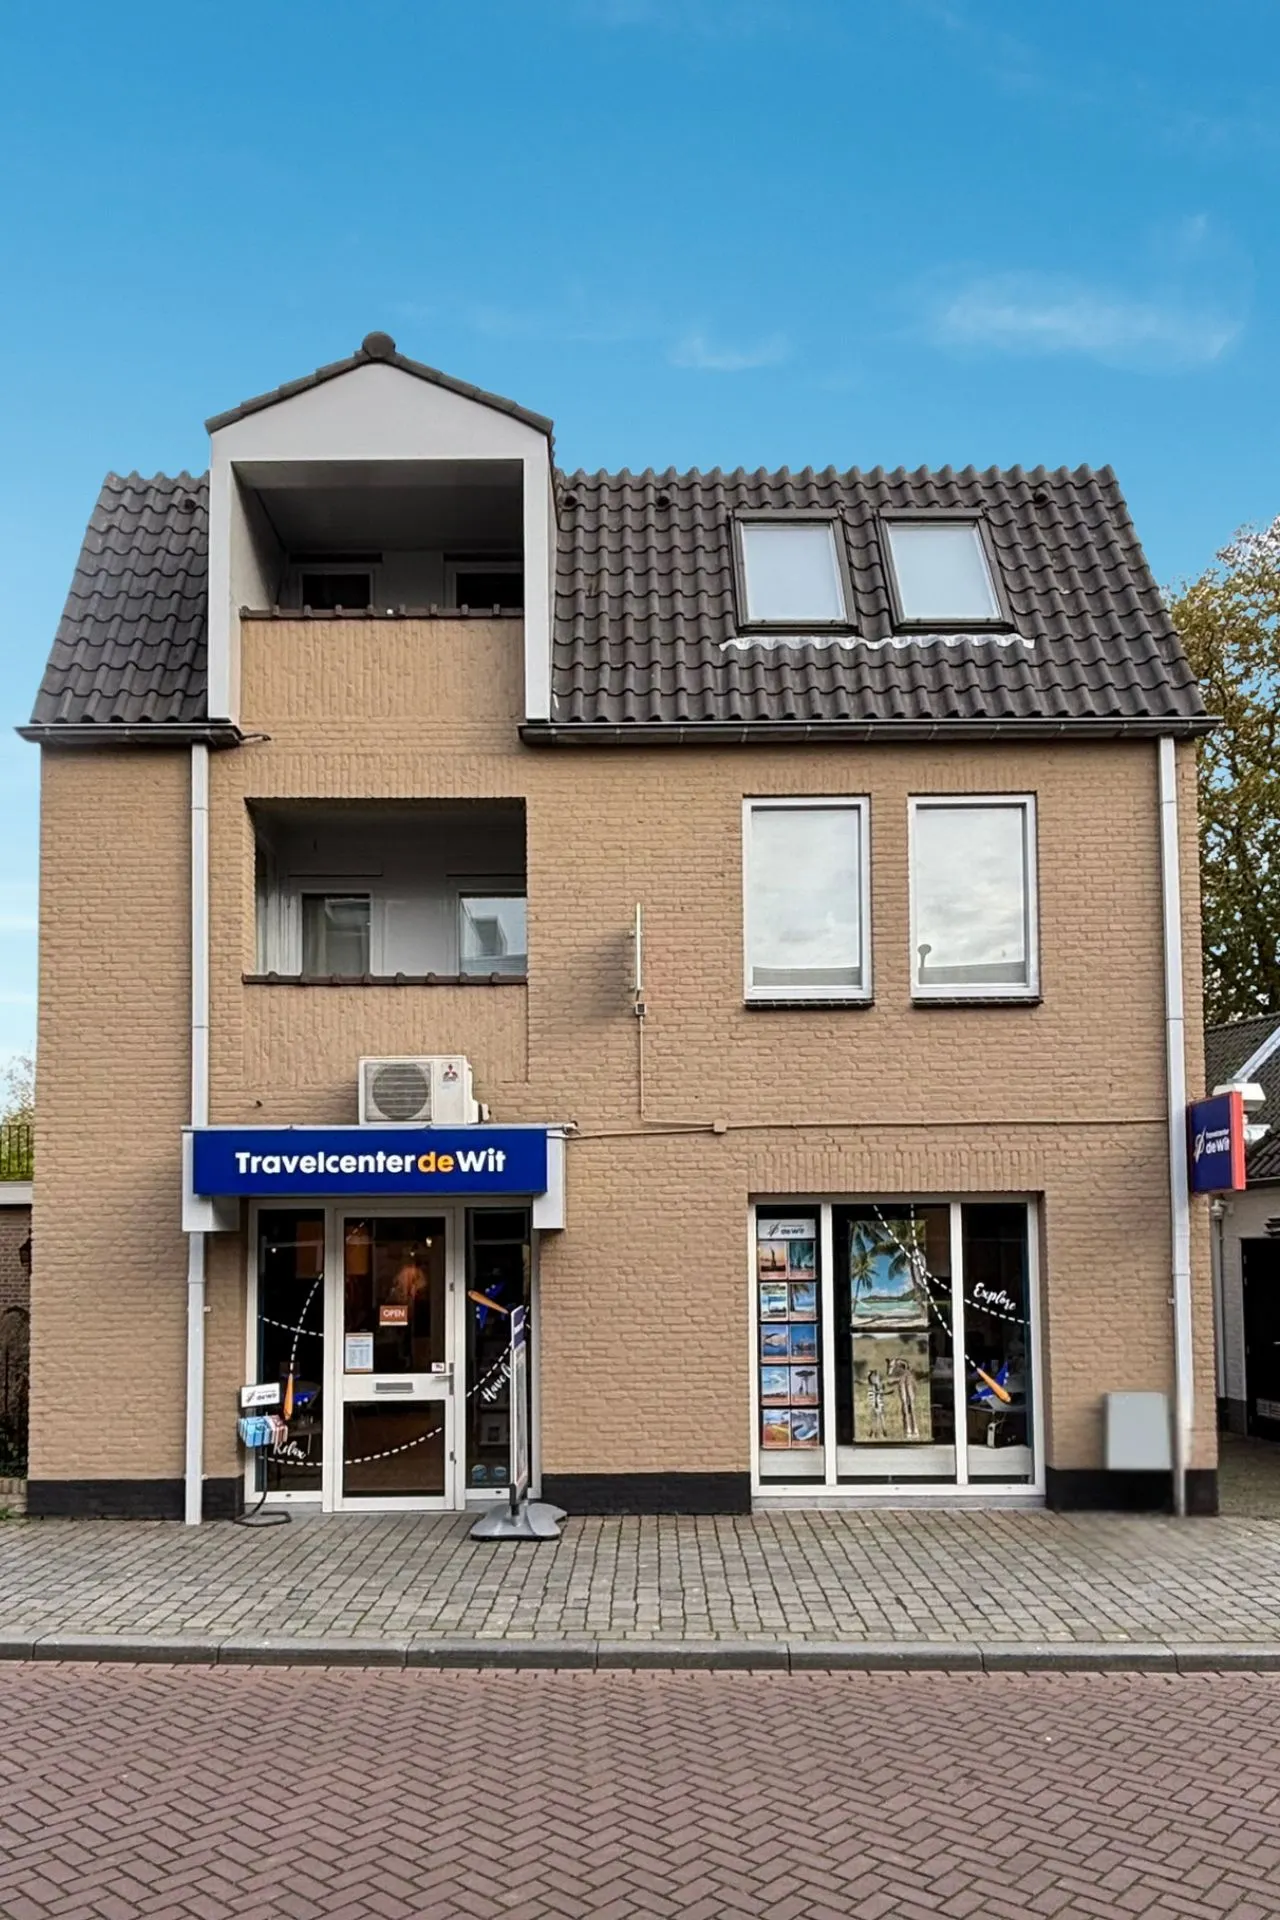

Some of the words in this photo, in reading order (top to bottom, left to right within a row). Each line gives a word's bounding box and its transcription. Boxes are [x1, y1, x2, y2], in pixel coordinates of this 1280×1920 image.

[973, 1282, 1017, 1310] Explore
[382, 1309, 406, 1318] OPEN
[481, 1374, 507, 1403] Have
